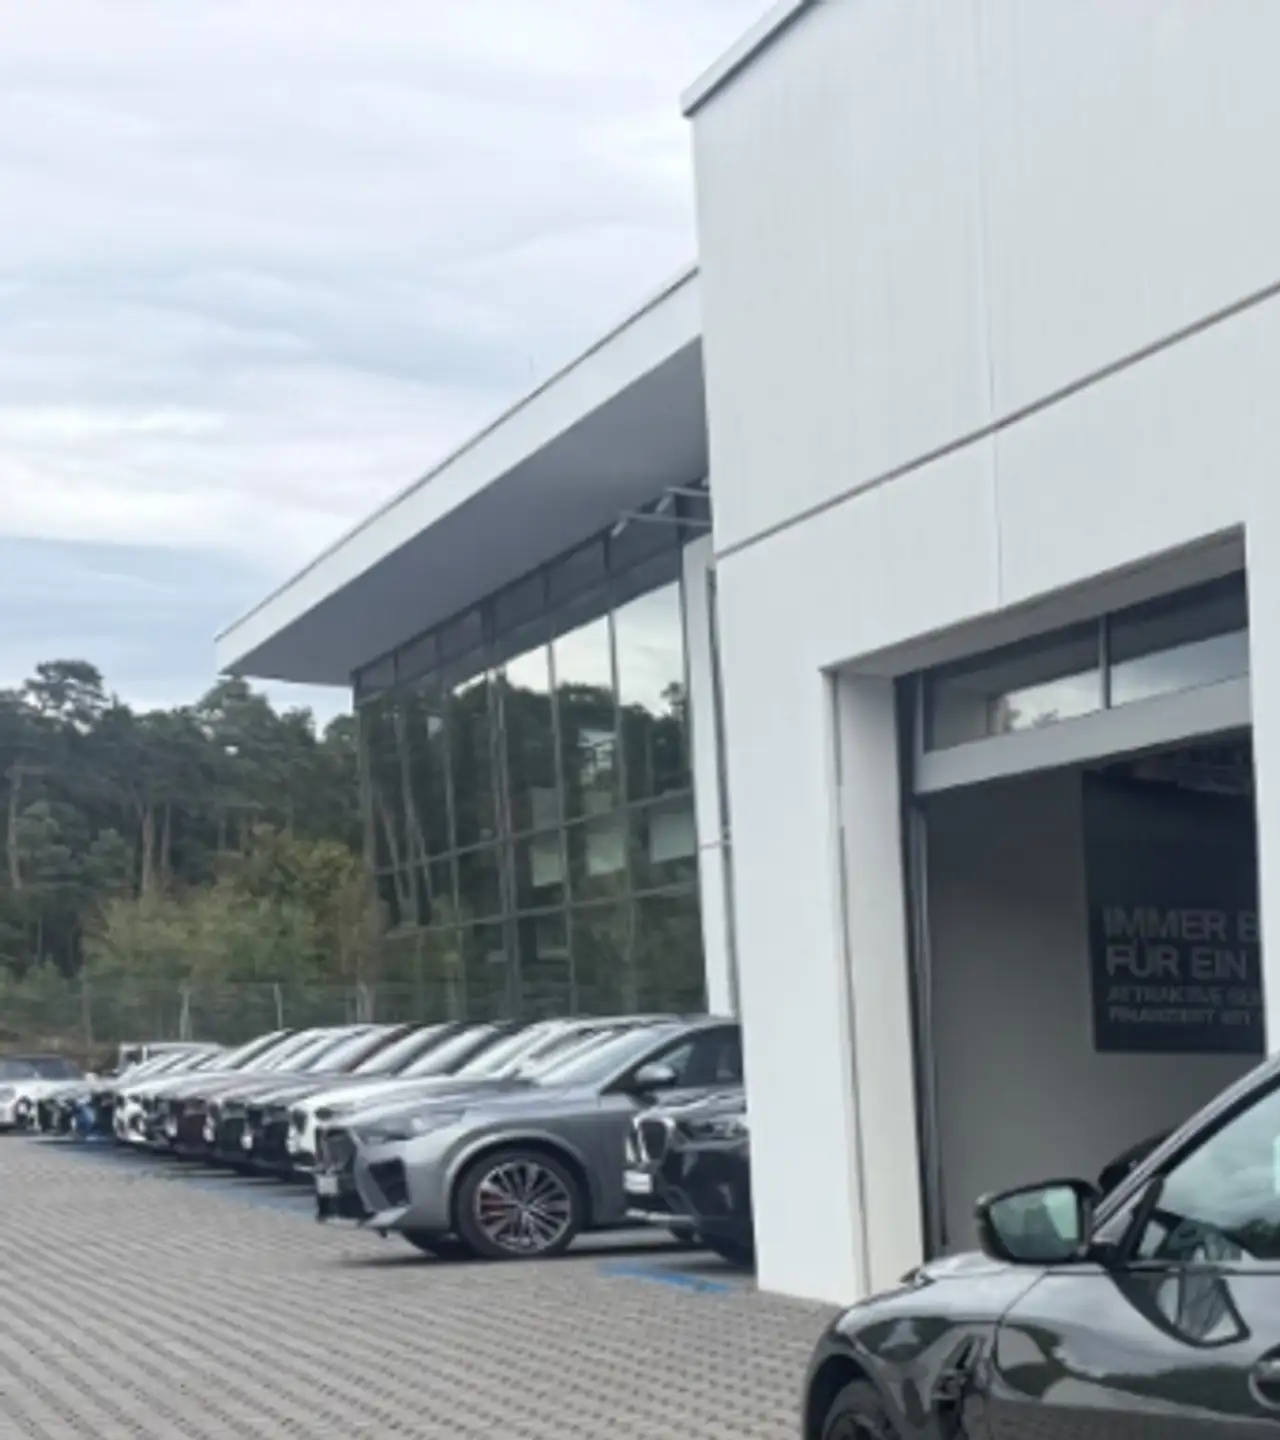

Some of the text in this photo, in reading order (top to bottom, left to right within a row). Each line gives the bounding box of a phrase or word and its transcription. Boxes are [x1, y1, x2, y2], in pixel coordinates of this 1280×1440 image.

[1103, 906, 1226, 941] IMMER
[1106, 939, 1247, 981] FÜR EIN
